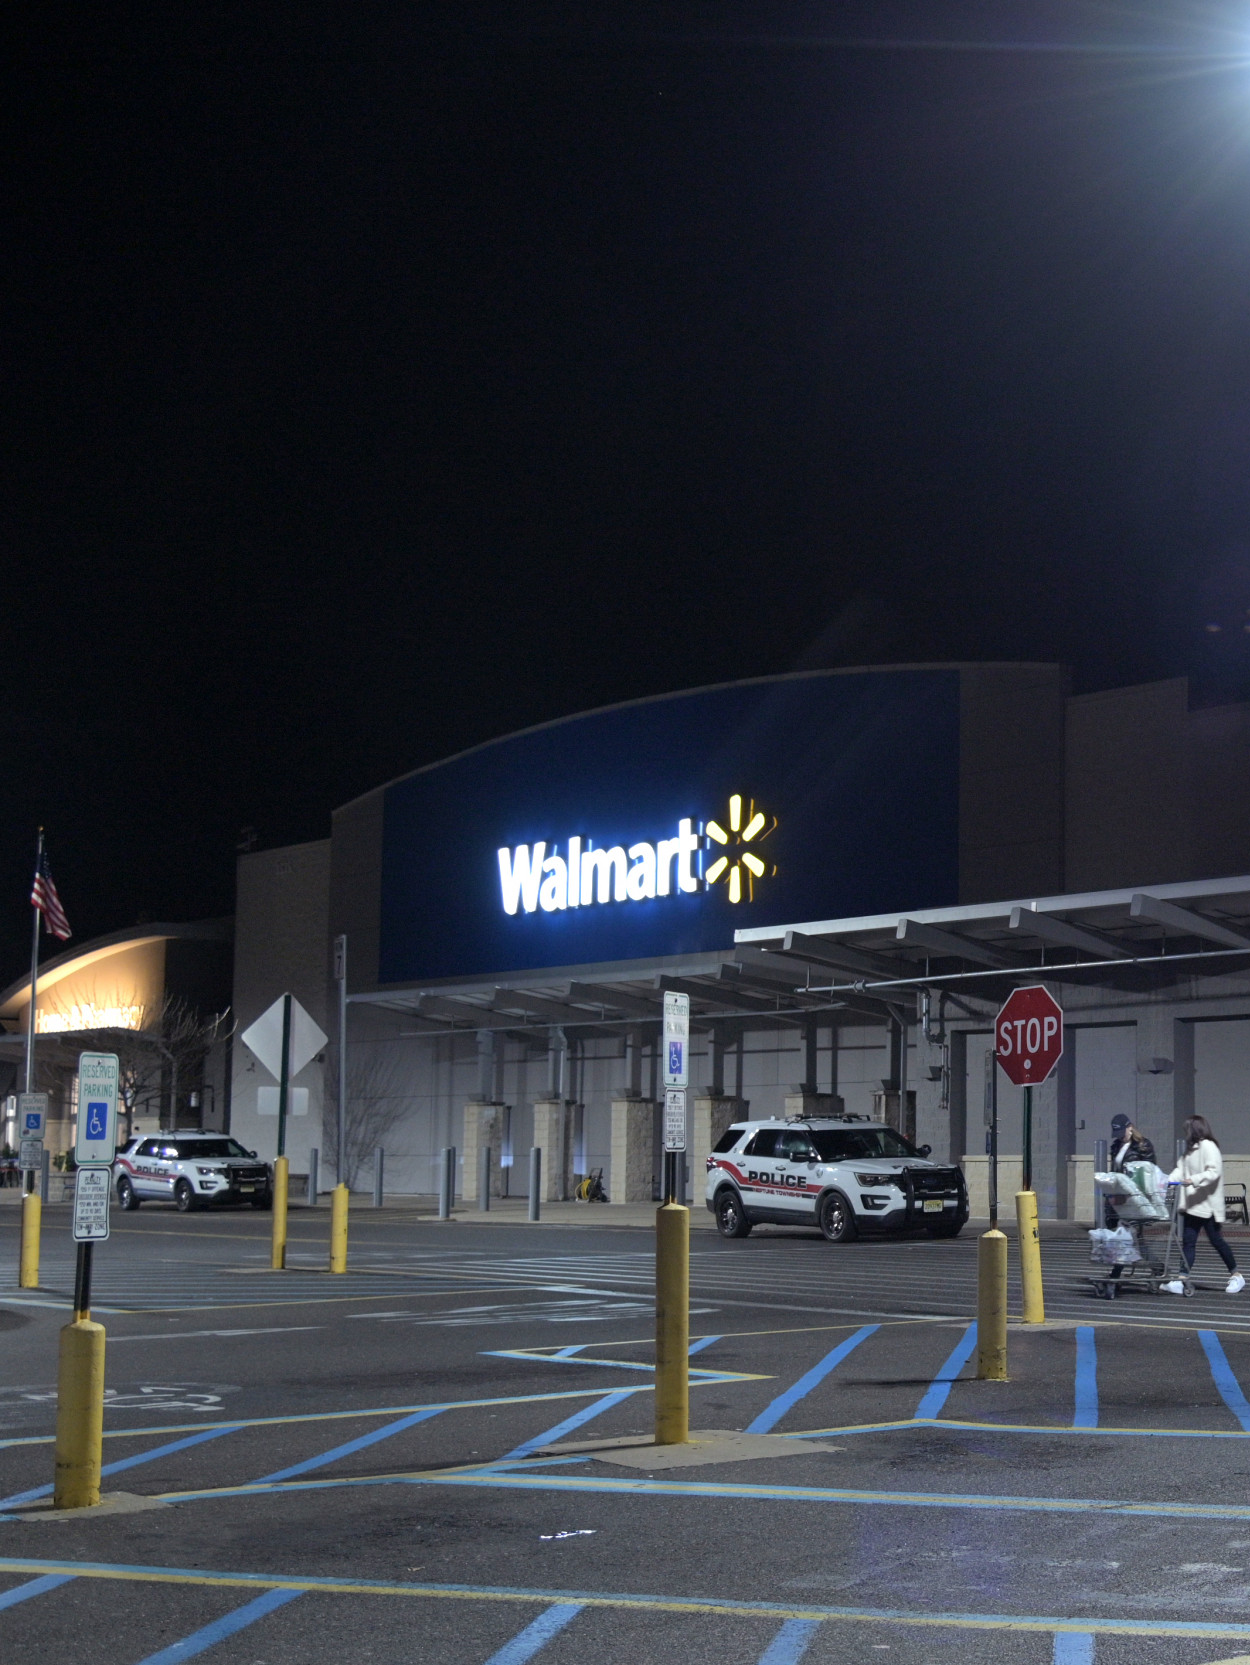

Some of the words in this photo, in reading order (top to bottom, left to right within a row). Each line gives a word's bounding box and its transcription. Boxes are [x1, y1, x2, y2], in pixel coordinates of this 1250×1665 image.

[498, 818, 698, 915] Walmart
[665, 1003, 687, 1016] RESERVED
[1000, 1016, 1058, 1056] STOP
[82, 1064, 115, 1079] RESERVED
[84, 1083, 113, 1097] PARKING
[136, 1165, 169, 1177] POLICE
[748, 1170, 807, 1189] POLICE
